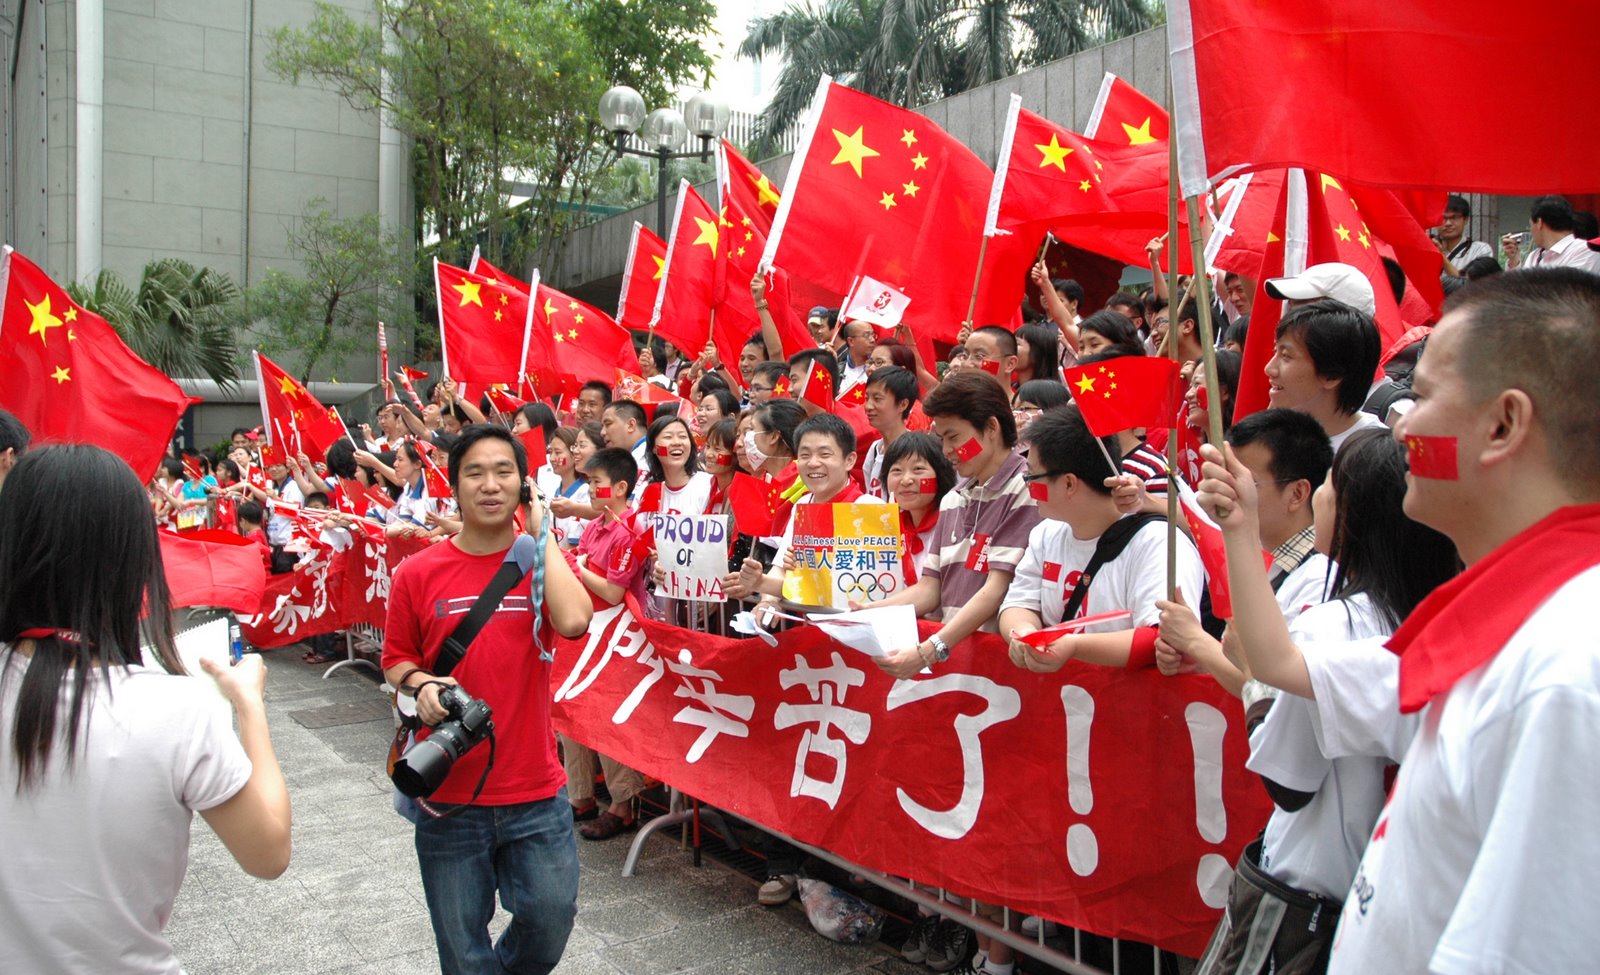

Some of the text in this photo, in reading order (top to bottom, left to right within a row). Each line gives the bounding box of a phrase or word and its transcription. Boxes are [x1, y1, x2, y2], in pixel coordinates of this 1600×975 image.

[653, 515, 724, 544] PROUD
[838, 536, 861, 546] Love
[863, 536, 897, 546] PEACE
[676, 548, 694, 567] OF
[794, 548, 898, 571] 中國人愛和平
